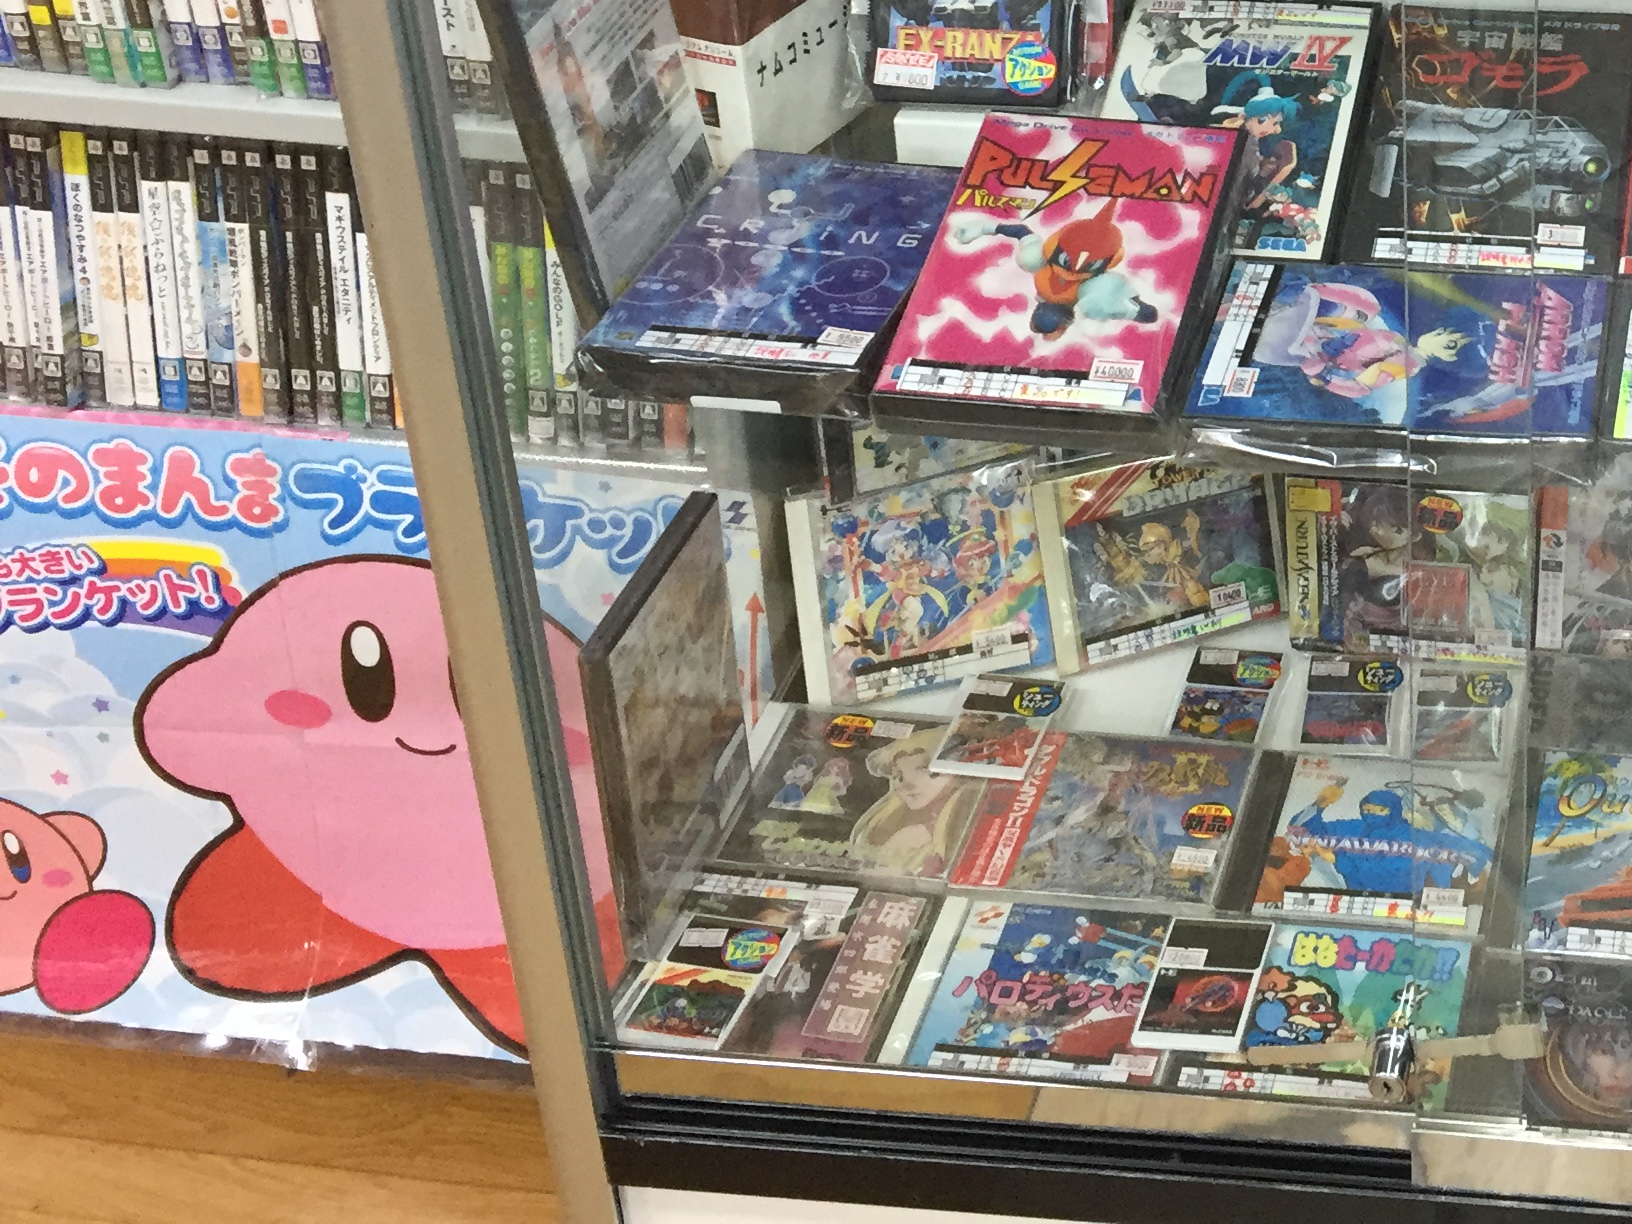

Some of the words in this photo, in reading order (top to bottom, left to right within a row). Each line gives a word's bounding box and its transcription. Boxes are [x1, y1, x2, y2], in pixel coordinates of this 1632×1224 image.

[958, 136, 1217, 208] PULSEMAN
[70, 182, 87, 274] ぼくのなつやすみ4
[0, 567, 221, 625] ランケット!
